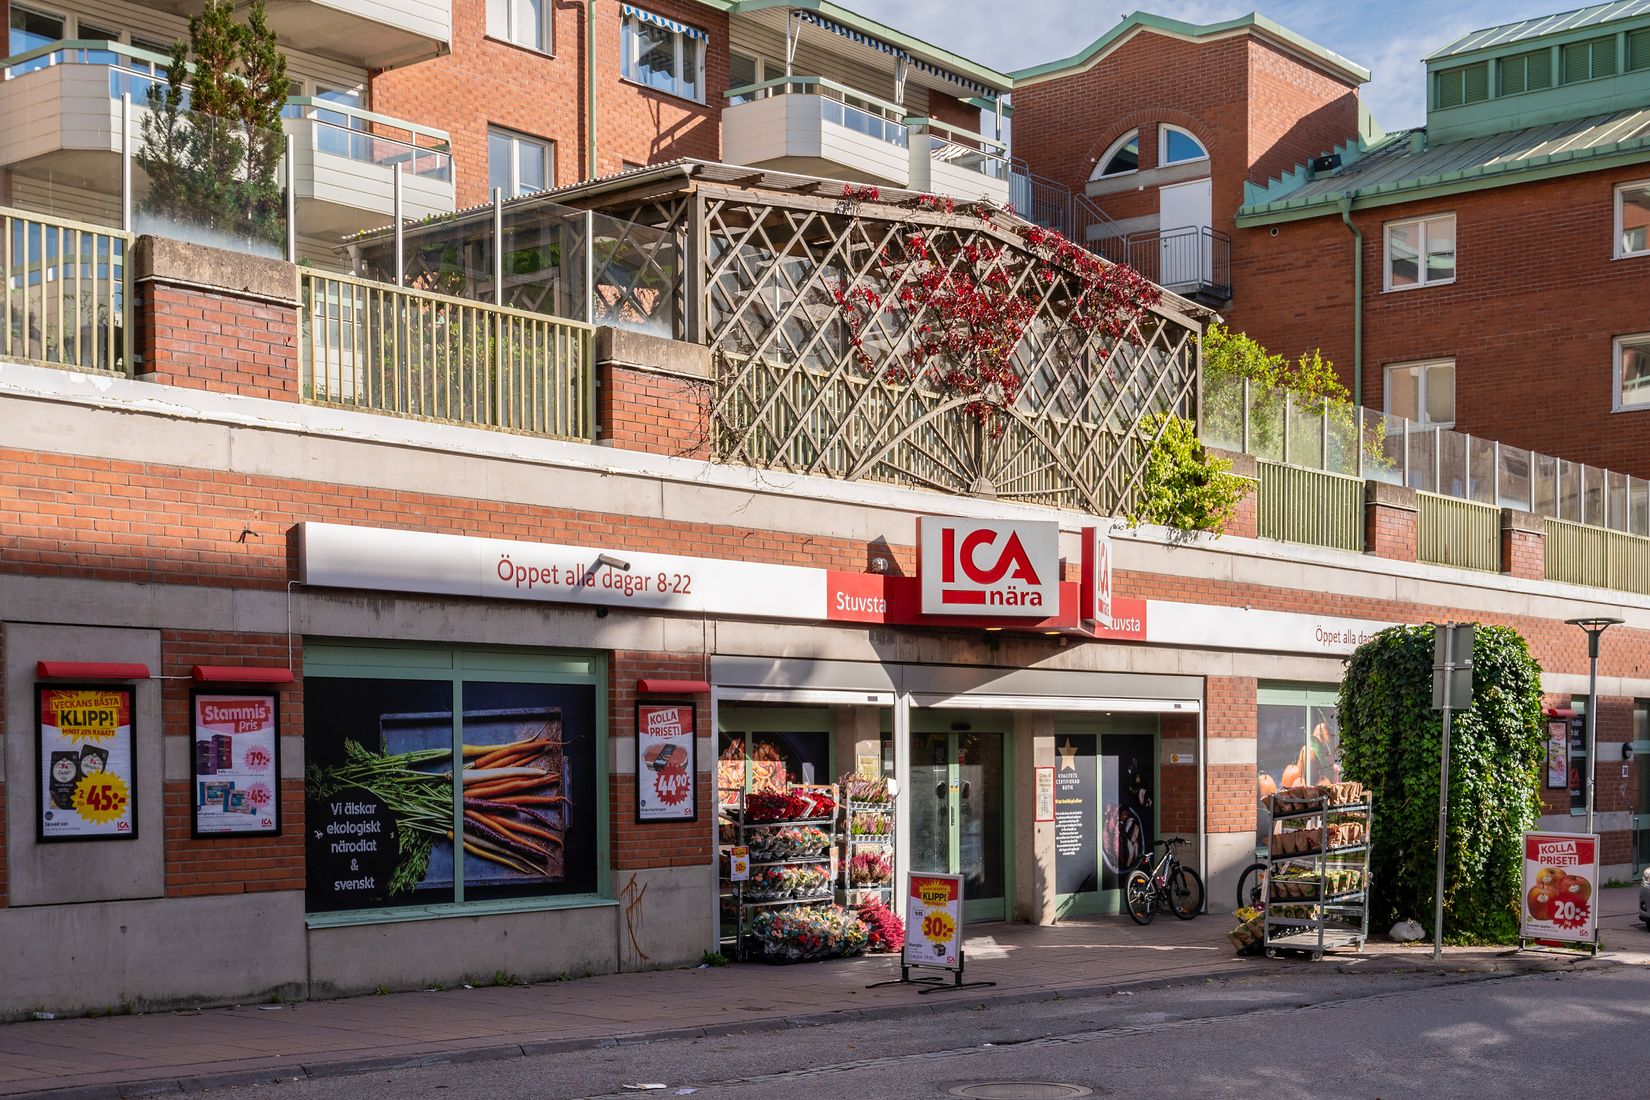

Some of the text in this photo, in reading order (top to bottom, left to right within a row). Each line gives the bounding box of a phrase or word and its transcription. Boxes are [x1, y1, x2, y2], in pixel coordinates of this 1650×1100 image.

[941, 527, 1042, 586] ICA
[497, 553, 692, 597] Öppet alla dagar 8-22
[836, 590, 887, 614] Stuvsta
[989, 586, 1043, 607] nära
[1104, 615, 1141, 633] tuvsta
[1315, 624, 1341, 647] Öppet
[1343, 628, 1356, 645] alla
[53, 699, 93, 709] VECKANS
[60, 709, 114, 727] KLIPP!
[205, 703, 267, 721] Stammis
[649, 711, 678, 726] KOLLA
[240, 719, 258, 733] Pris
[649, 726, 680, 737] PRISET!
[79, 789, 84, 799] 2
[86, 785, 126, 811] 45:-
[330, 801, 377, 816] Vi älskar
[116, 821, 129, 829] ICA
[326, 820, 381, 836] ekologiskt
[331, 839, 377, 853] närodlat
[1541, 843, 1575, 855] KOLLA
[350, 858, 359, 871] &
[1540, 856, 1577, 866] PRISET!
[334, 876, 375, 891] svenskt
[922, 891, 947, 901] KLIPP!
[1554, 900, 1587, 920] 20:-
[923, 916, 954, 938] 30:-
